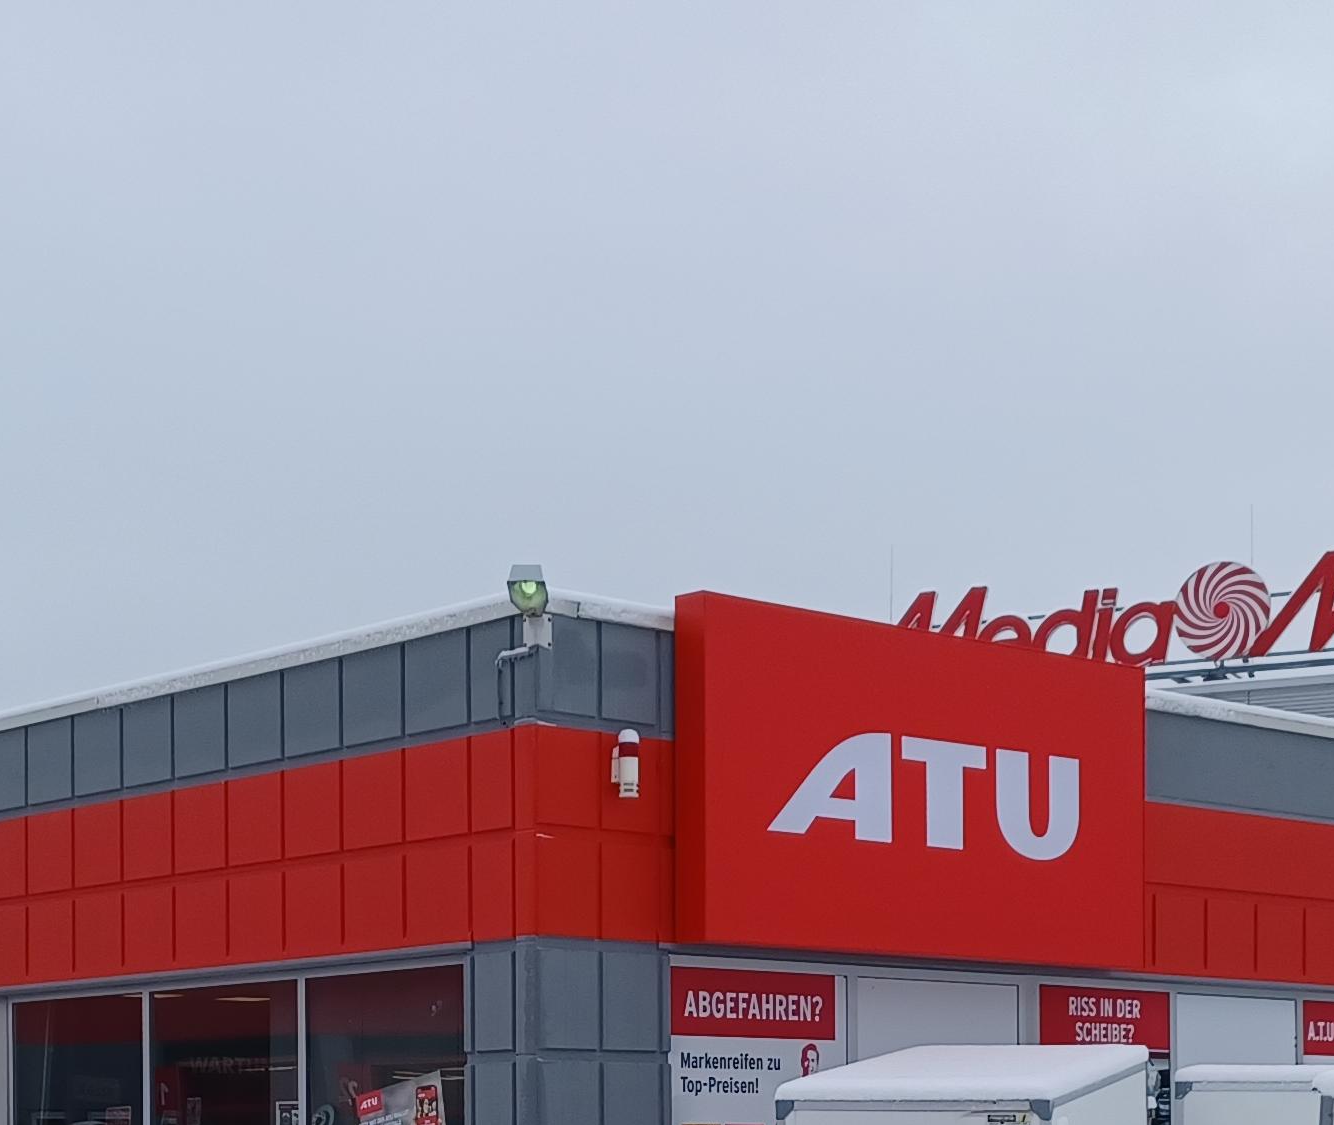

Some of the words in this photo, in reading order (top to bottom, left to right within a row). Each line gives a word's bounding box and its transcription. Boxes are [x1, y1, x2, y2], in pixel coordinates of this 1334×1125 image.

[767, 732, 1079, 860] ATU
[684, 990, 823, 1022] ABGEFAHREN?
[1068, 996, 1096, 1017] RISS
[1100, 998, 1113, 1017] IN
[1116, 999, 1141, 1019] DER
[1075, 1022, 1135, 1043] SCHEIBE?
[1307, 1021, 1334, 1041] A.T.U
[680, 1052, 763, 1071] Markenreifen
[767, 1057, 781, 1071] zu
[680, 1076, 759, 1097] Top-Preisen!
[360, 1096, 378, 1111] ATU
